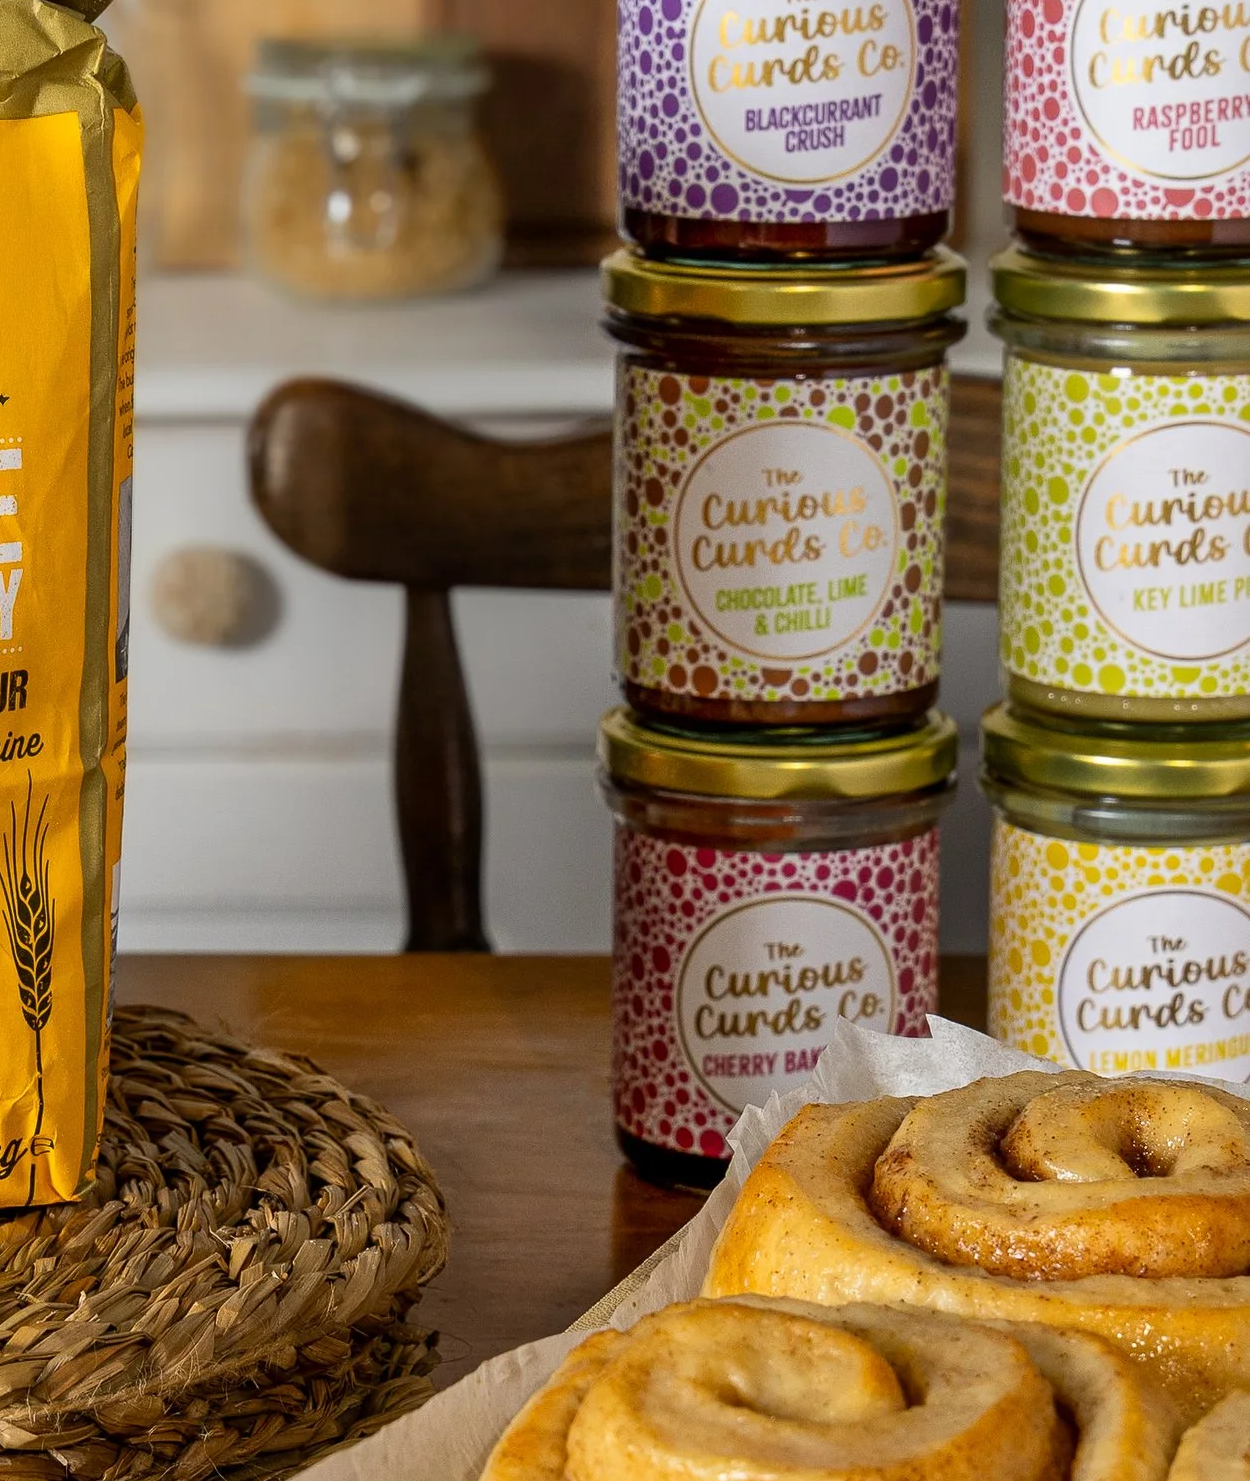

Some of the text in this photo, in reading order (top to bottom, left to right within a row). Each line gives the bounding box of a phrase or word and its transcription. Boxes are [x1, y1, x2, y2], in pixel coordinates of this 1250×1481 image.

[718, 3, 888, 49] Curious
[707, 38, 905, 93] Curds Co.
[1088, 40, 1227, 90] Curds
[744, 93, 883, 132] BLACKCURRANT
[784, 125, 845, 153] CRUSH
[1168, 124, 1221, 152] FOOL
[762, 468, 804, 487] The
[1168, 467, 1211, 488] The
[702, 486, 868, 531] Curious
[691, 520, 888, 572] Curds Co.
[1094, 527, 1231, 572] Curds
[827, 573, 868, 602] LIME
[1133, 585, 1173, 612] KEY
[1179, 579, 1227, 609] LIME
[754, 606, 832, 636] & CHILLI
[763, 941, 805, 960] The
[1147, 934, 1187, 953] The
[705, 956, 868, 1001] Curious
[1086, 949, 1250, 994] Curious
[693, 990, 885, 1040] Curds Co.
[1076, 991, 1209, 1034] Curds
[703, 1051, 779, 1078] CHERRY
[1089, 1046, 1158, 1073] LEMON
